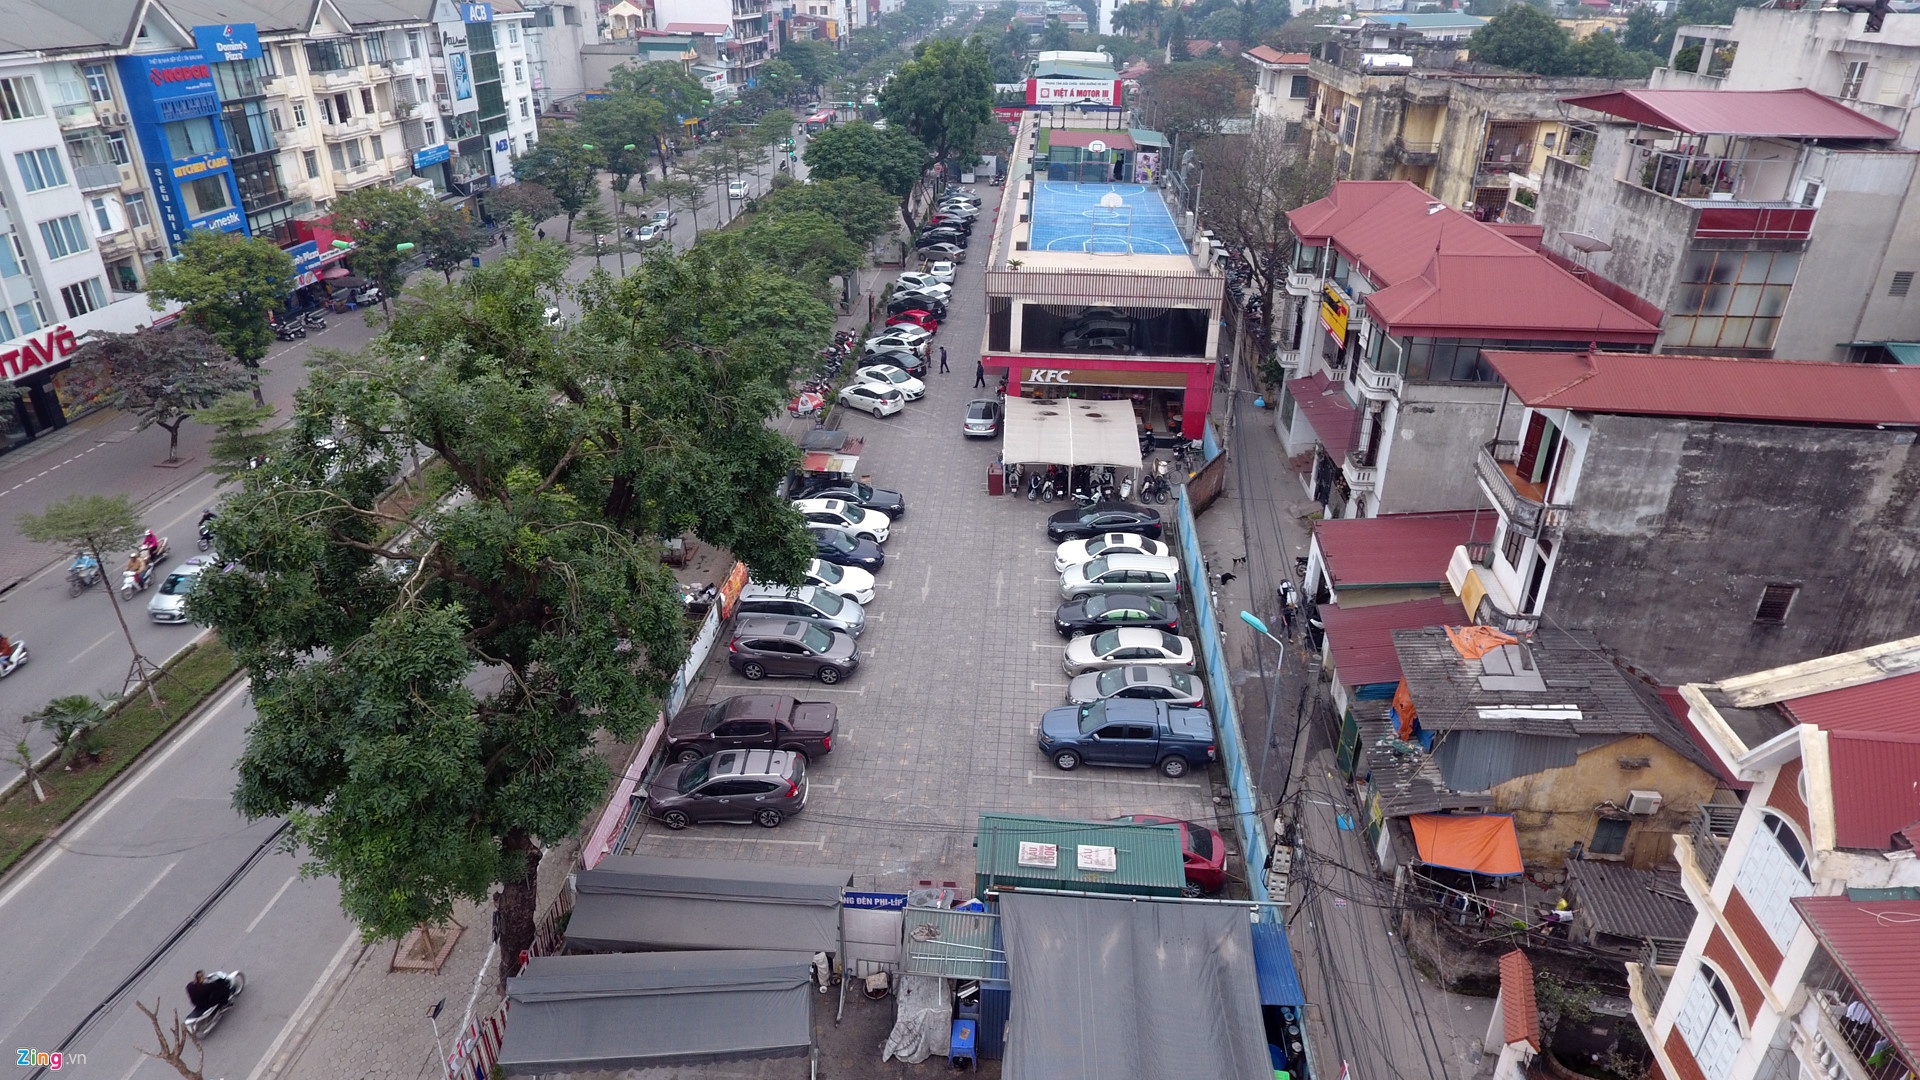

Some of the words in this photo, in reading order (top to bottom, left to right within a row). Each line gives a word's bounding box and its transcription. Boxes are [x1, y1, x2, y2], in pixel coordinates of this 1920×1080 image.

[469, 5, 488, 21] ACB
[216, 39, 248, 52] Domino's
[225, 51, 243, 61] Pizza
[162, 64, 210, 82] NODOR
[1053, 88, 1068, 99] VIỆT
[1069, 88, 1075, 98] Á
[1076, 89, 1101, 98] MOTOR
[1102, 90, 1110, 98] III
[495, 138, 509, 154] ACB
[173, 162, 207, 178] KITCHEN
[207, 156, 229, 170] CARE
[302, 248, 320, 261] Pizza
[1028, 369, 1071, 383] KFC
[843, 896, 855, 905] NG
[856, 896, 873, 905] ĐÈN
[874, 897, 904, 906] PHI-LÍP
